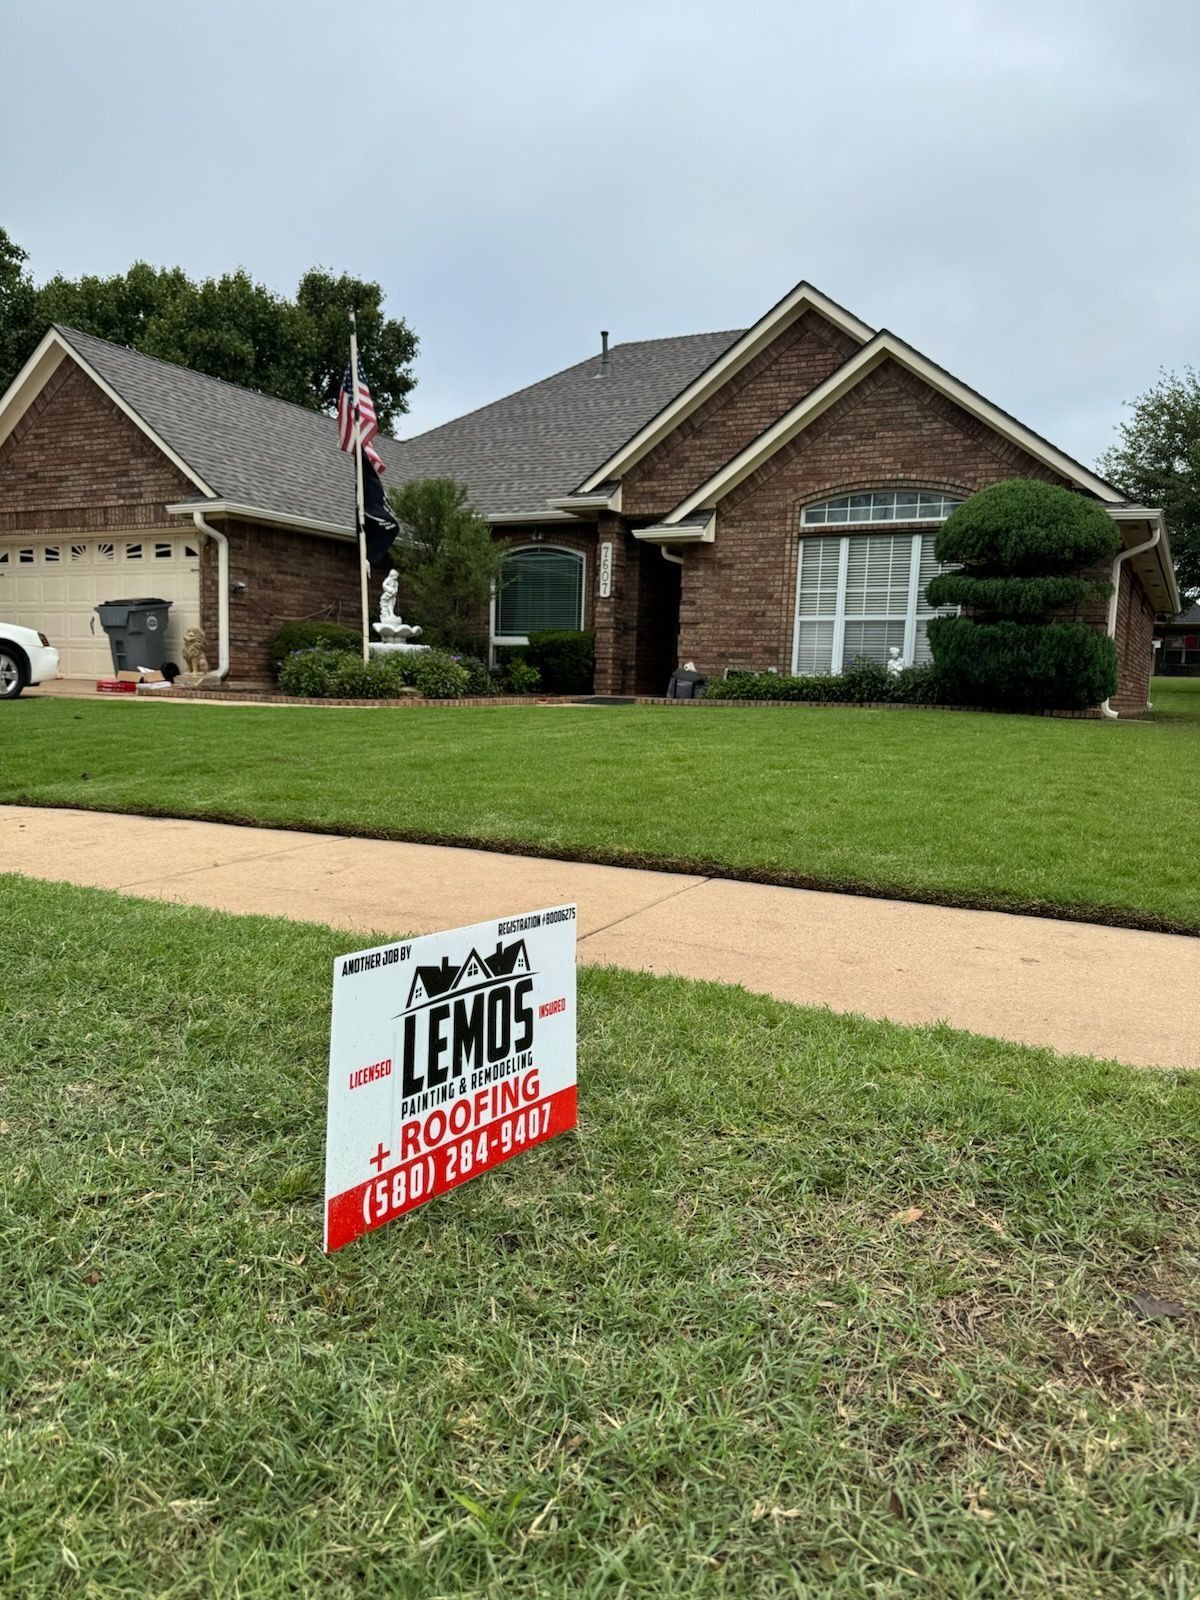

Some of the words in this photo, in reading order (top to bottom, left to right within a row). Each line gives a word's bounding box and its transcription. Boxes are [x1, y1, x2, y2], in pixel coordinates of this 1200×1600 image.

[602, 546, 610, 594] 7607
[498, 914, 541, 936] REGISTRATION
[341, 952, 382, 977] ANOTHER
[382, 948, 400, 966] JOB
[400, 944, 412, 961] BY
[538, 998, 566, 1019] INSURED
[402, 977, 534, 1100] LEMOS
[349, 1059, 392, 1090] LICENSED
[401, 1080, 455, 1120] PAINTING
[459, 1077, 467, 1096] &
[471, 1051, 533, 1090] REMODELING
[401, 1068, 540, 1161] ROOFING
[362, 1155, 436, 1225] (580)
[445, 1101, 552, 1183] 284-9407
